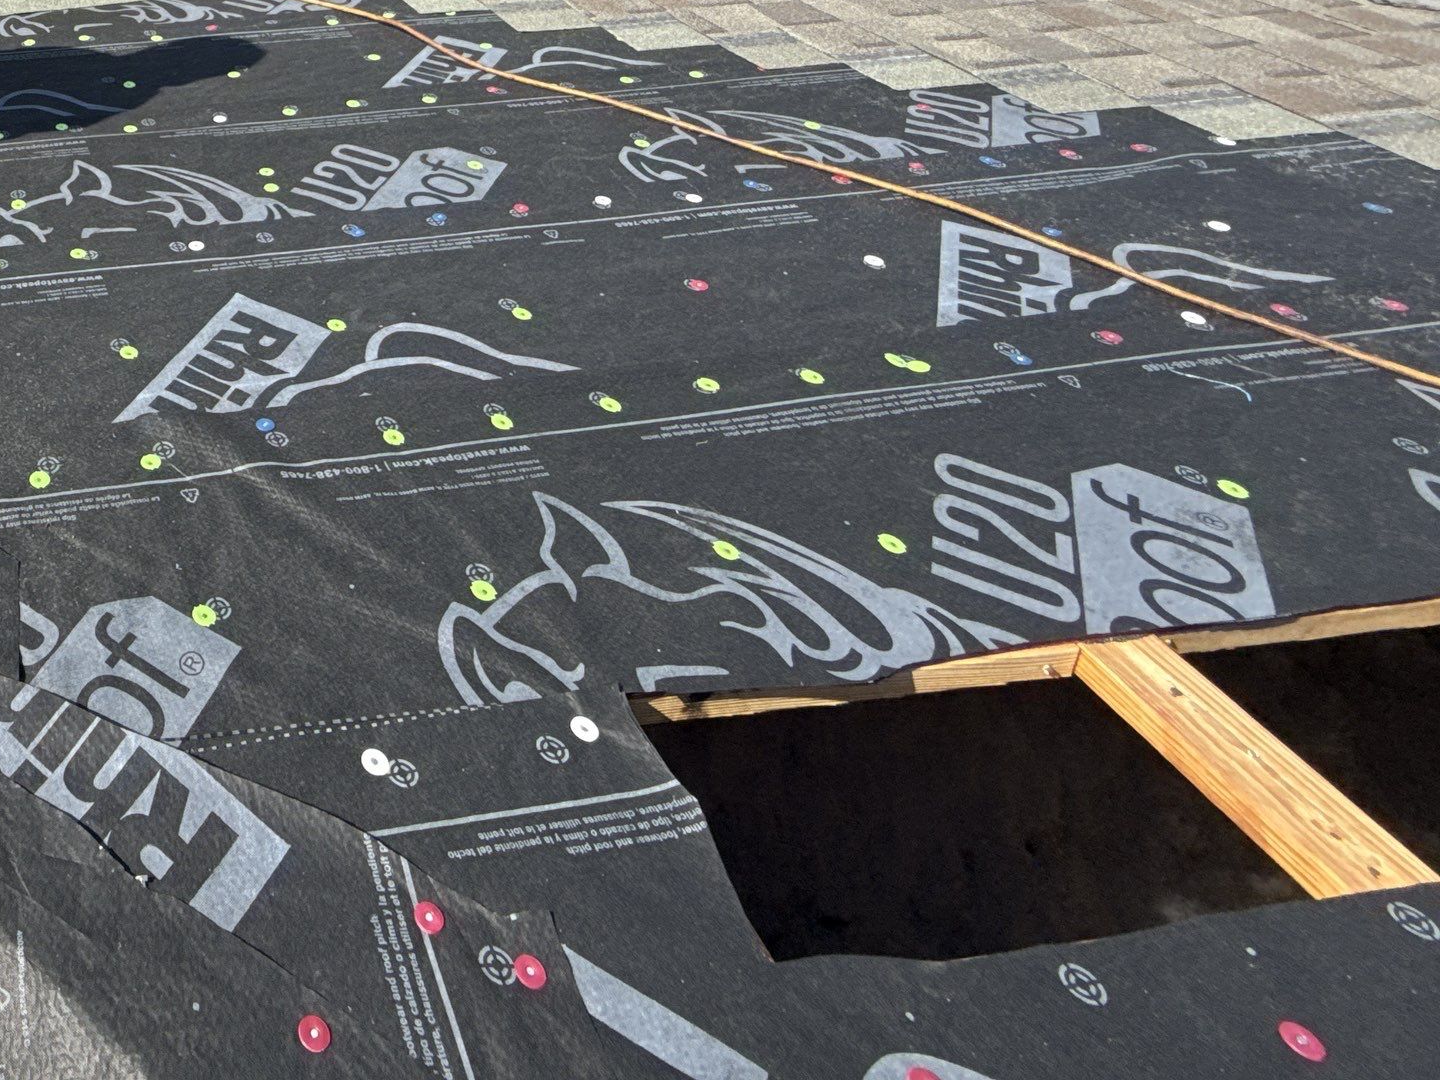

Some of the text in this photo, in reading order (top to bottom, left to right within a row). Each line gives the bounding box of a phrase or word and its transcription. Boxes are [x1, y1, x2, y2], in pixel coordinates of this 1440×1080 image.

[290, 143, 401, 212] U20
[280, 443, 532, 483] www.eavetopeak.com 1-800-438-7465
[931, 452, 1082, 624] U20
[548, 817, 582, 832] utiliser
[582, 808, 636, 826] chaussures
[651, 815, 673, 830] tipo
[598, 822, 637, 838] calzado
[637, 820, 651, 832] de
[676, 820, 708, 836] ather,
[477, 828, 505, 841] pente
[543, 834, 554, 845] la
[562, 829, 589, 843] clima
[476, 844, 492, 856] del
[565, 842, 592, 857] pitch
[593, 840, 614, 852] roof
[614, 836, 634, 850] and
[447, 847, 476, 860] techo
[377, 894, 388, 907] la
[369, 914, 387, 947] pitch
[383, 918, 401, 953] clima
[394, 909, 414, 951] utiliser
[377, 946, 394, 975] roof
[385, 976, 402, 1003] and
[396, 964, 420, 1017] calzado
[406, 951, 437, 1026] chaussures
[411, 1019, 425, 1037] de
[418, 1038, 436, 1067] tipo
